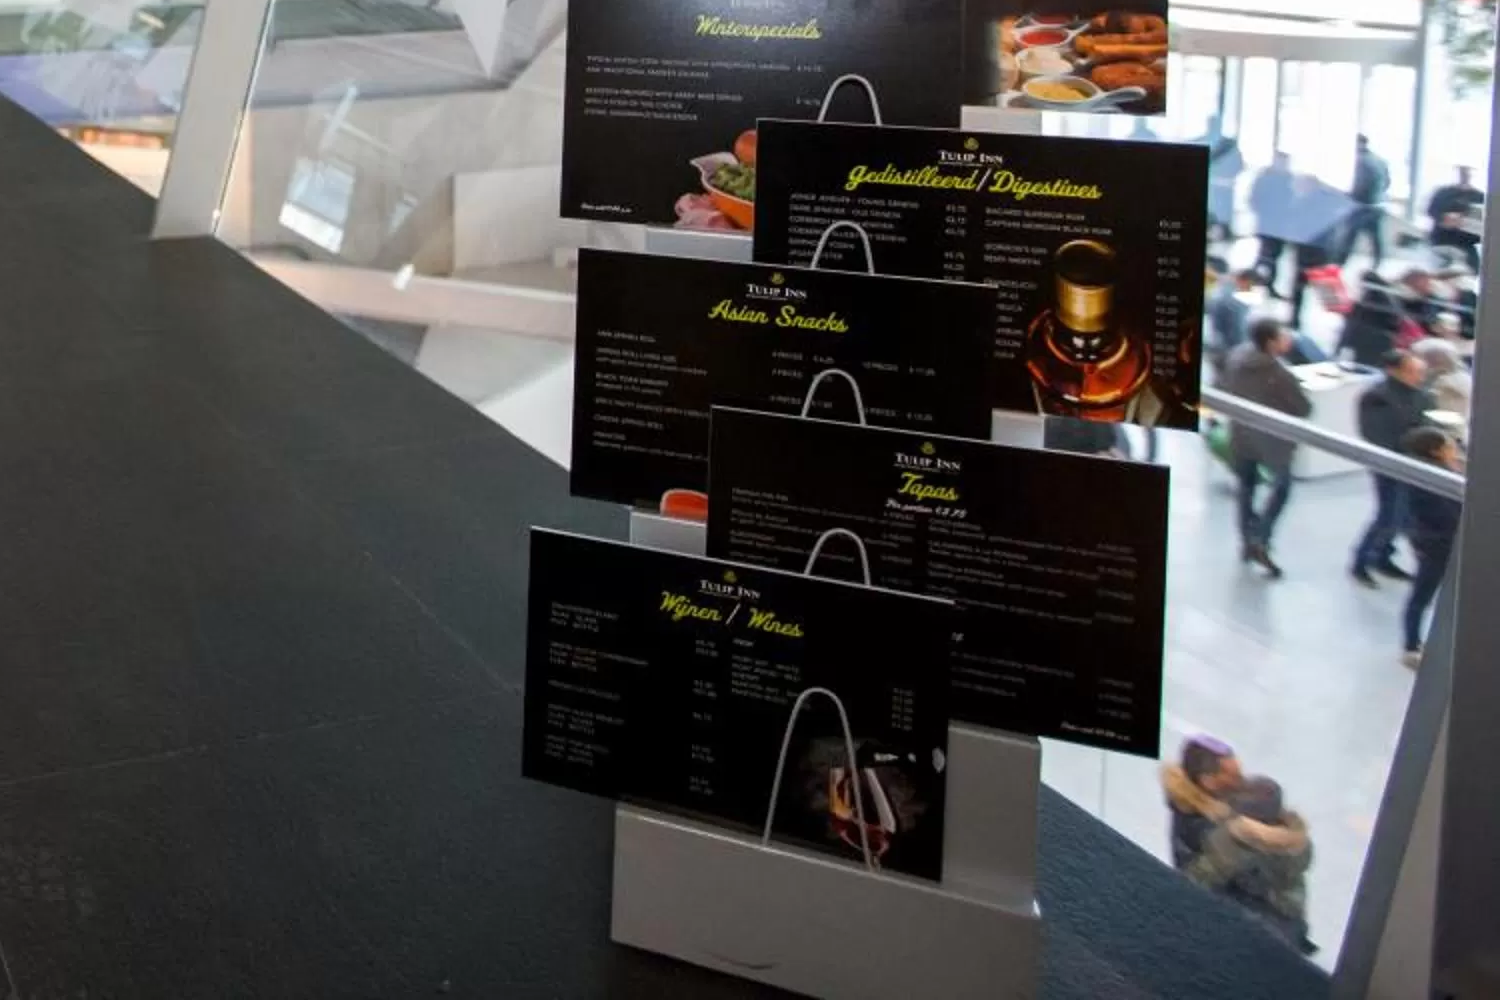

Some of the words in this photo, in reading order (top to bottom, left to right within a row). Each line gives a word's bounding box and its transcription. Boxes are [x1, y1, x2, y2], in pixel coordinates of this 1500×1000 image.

[694, 13, 823, 43] Winterspecials
[707, 298, 770, 326] Asian
[775, 304, 850, 335] Snacks
[895, 470, 960, 503] Tapas
[658, 589, 722, 623] Wijnen
[747, 606, 806, 638] Wines
